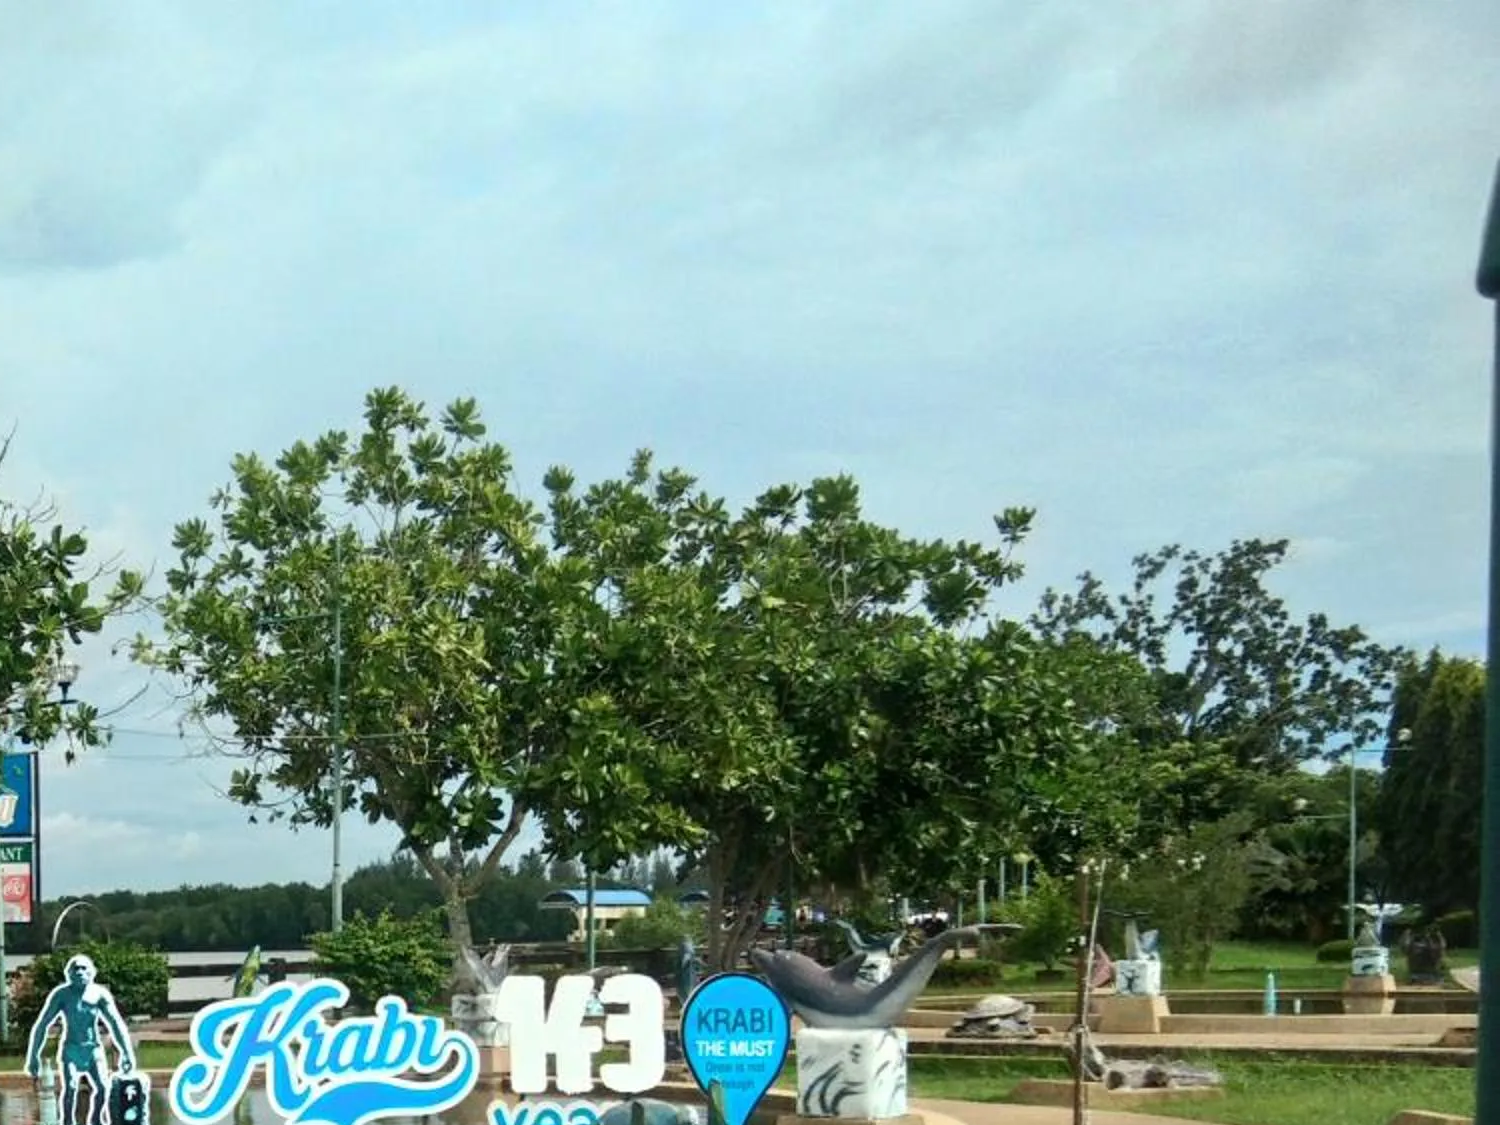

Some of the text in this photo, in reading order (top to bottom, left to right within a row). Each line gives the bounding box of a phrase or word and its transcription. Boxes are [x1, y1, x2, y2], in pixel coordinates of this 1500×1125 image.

[697, 1008, 773, 1033] KRABI
[695, 1040, 774, 1056] THE MUST
